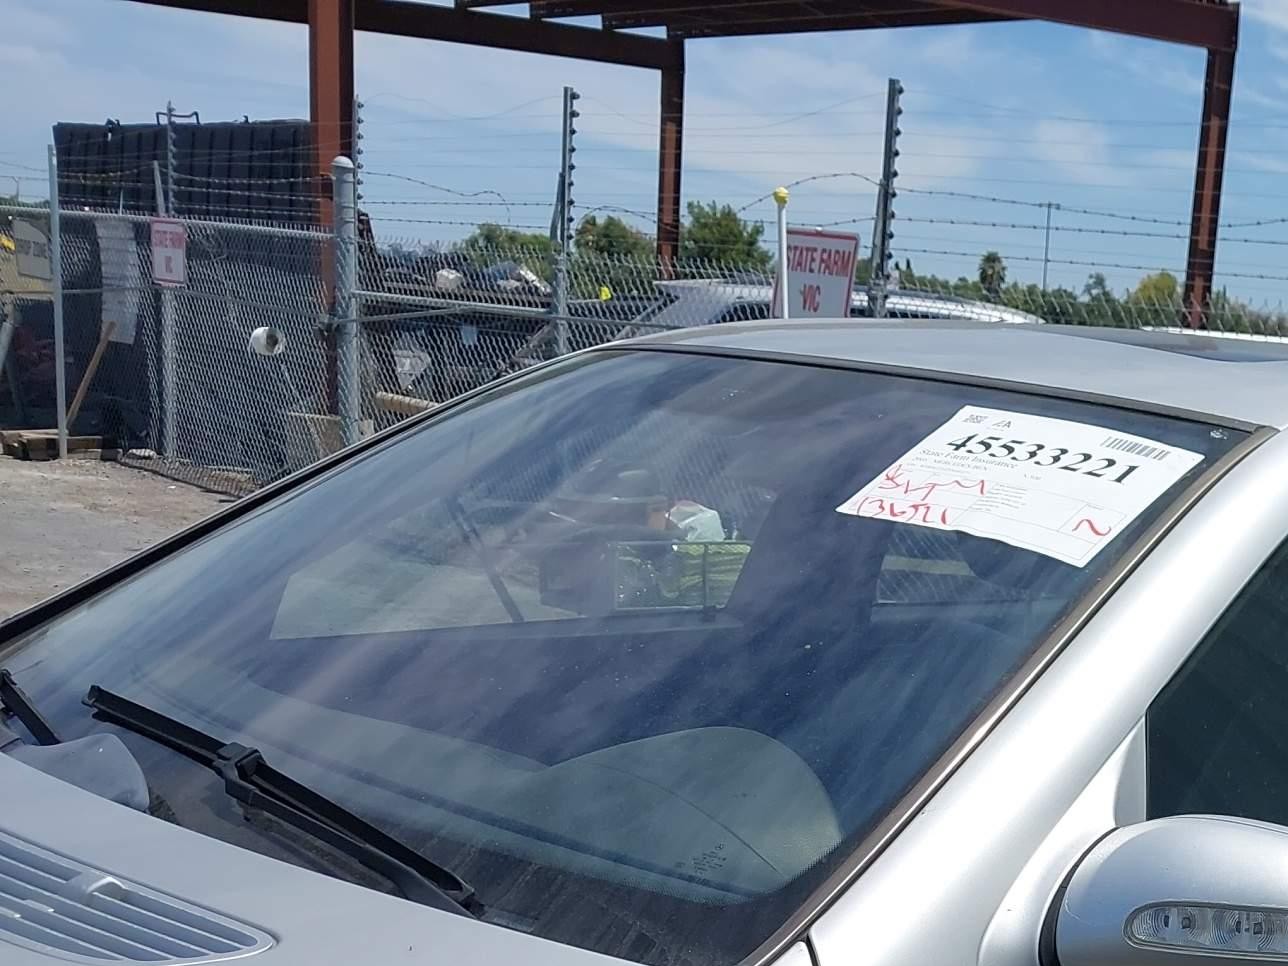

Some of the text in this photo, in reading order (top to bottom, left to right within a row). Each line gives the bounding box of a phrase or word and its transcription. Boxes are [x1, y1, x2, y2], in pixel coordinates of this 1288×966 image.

[819, 247, 852, 278] FARM
[802, 283, 821, 313] VIC
[945, 433, 1140, 484] 45533221
